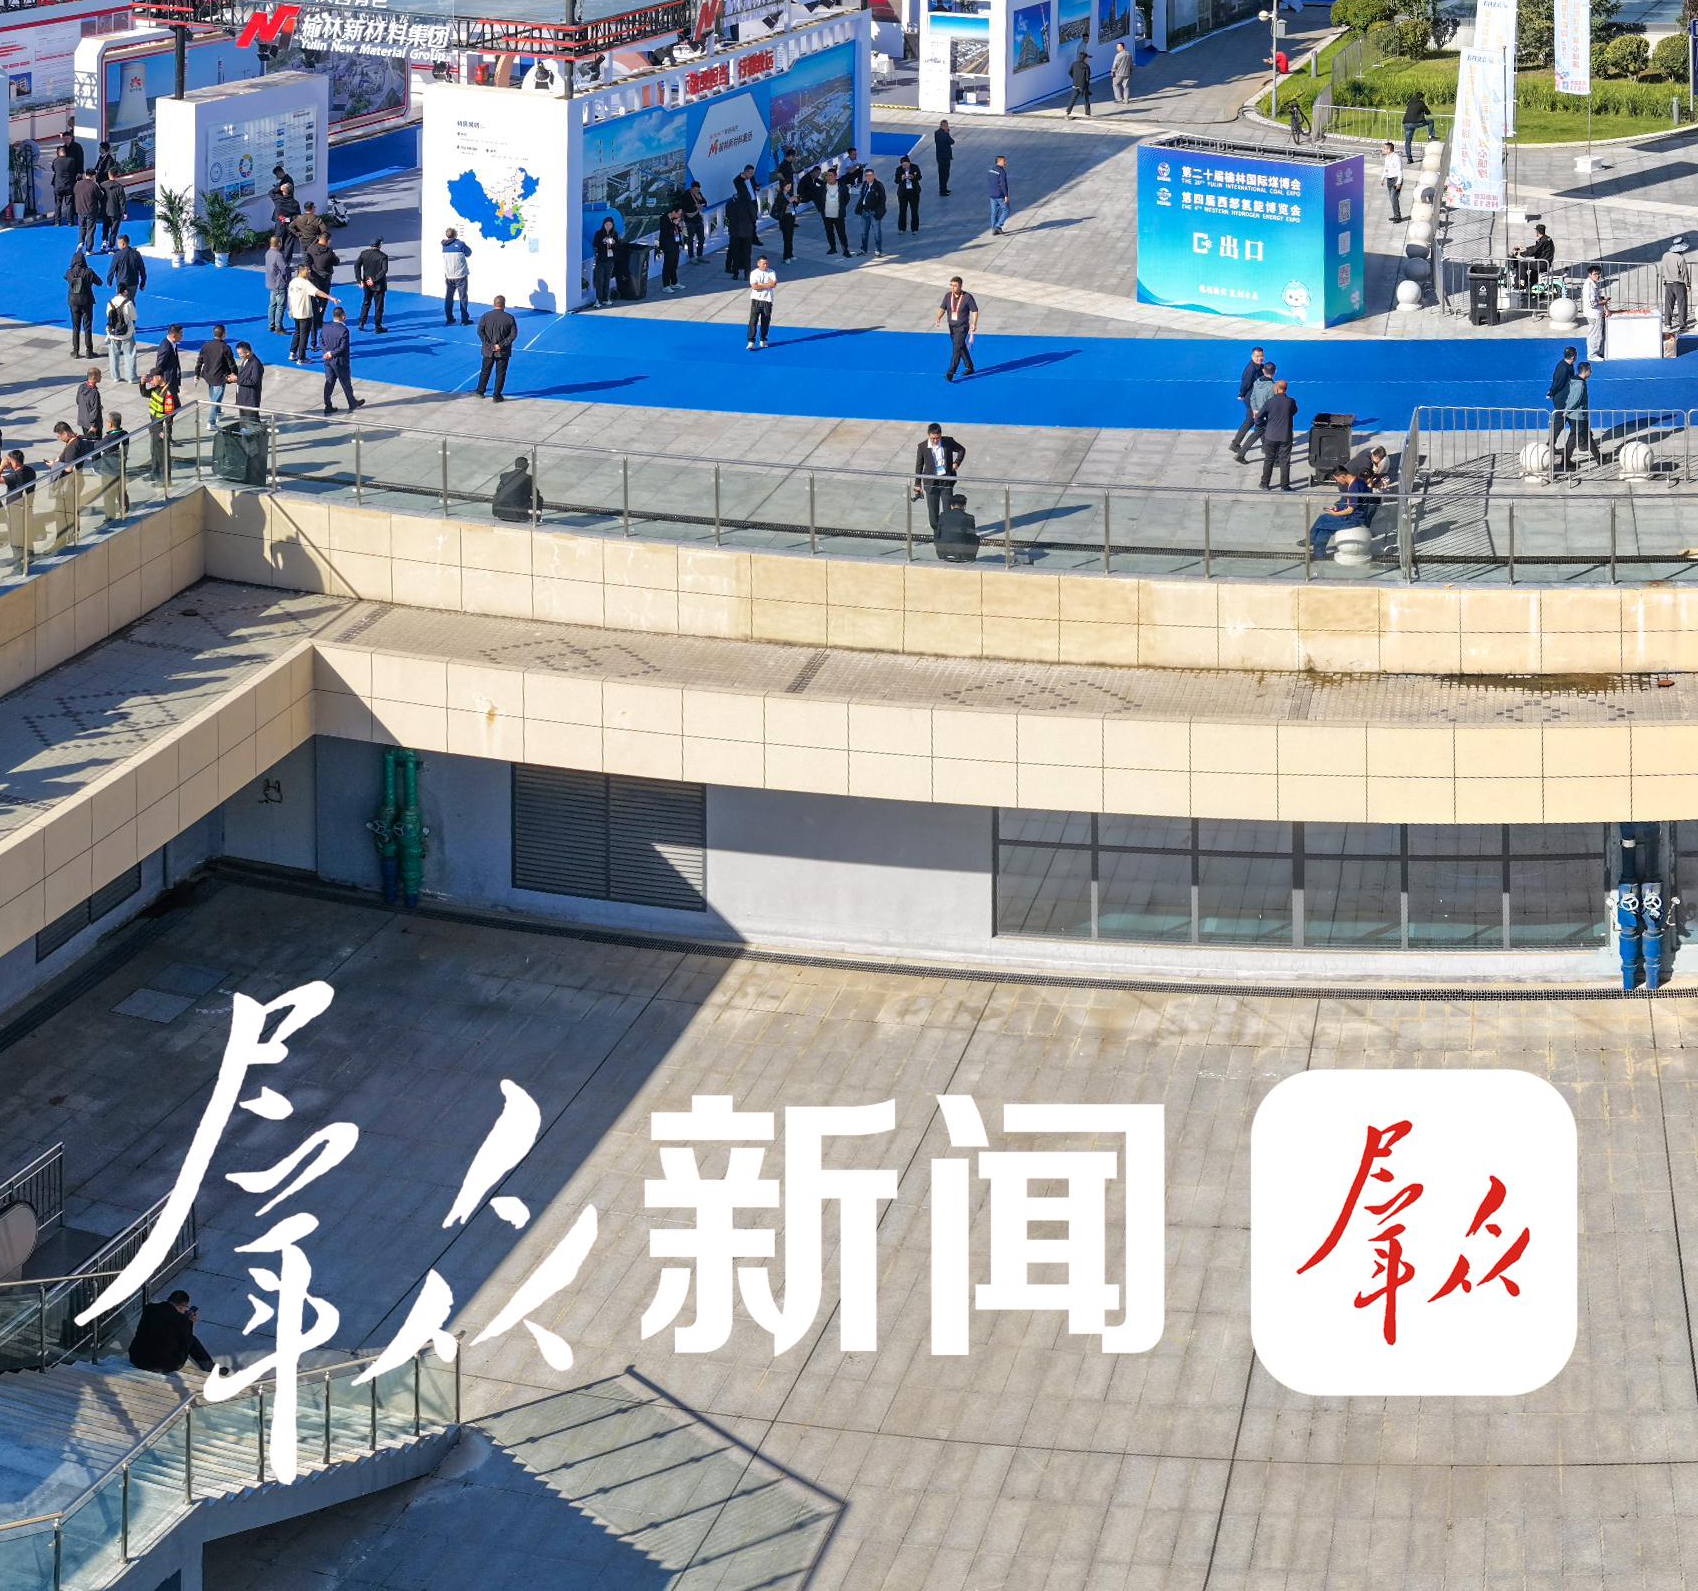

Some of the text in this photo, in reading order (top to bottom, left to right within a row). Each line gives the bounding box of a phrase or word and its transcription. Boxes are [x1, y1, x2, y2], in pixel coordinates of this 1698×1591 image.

[301, 14, 451, 48] 榆林新材料集团
[301, 37, 447, 63] Yulin New Material Group
[1181, 165, 1302, 191] 第二十届榆林国际煤博会
[1225, 183, 1267, 194] INTERNATIONAL
[1269, 187, 1284, 196] COAL
[1286, 189, 1301, 197] EXPO
[1181, 191, 1302, 217] 第四届西部氢能博览会
[1204, 206, 1229, 216] WESTERN
[1231, 209, 1261, 220] HYDROGEN
[1262, 212, 1284, 222] ENERGY
[1285, 214, 1301, 223] EXPO
[1219, 234, 1264, 262] 出口
